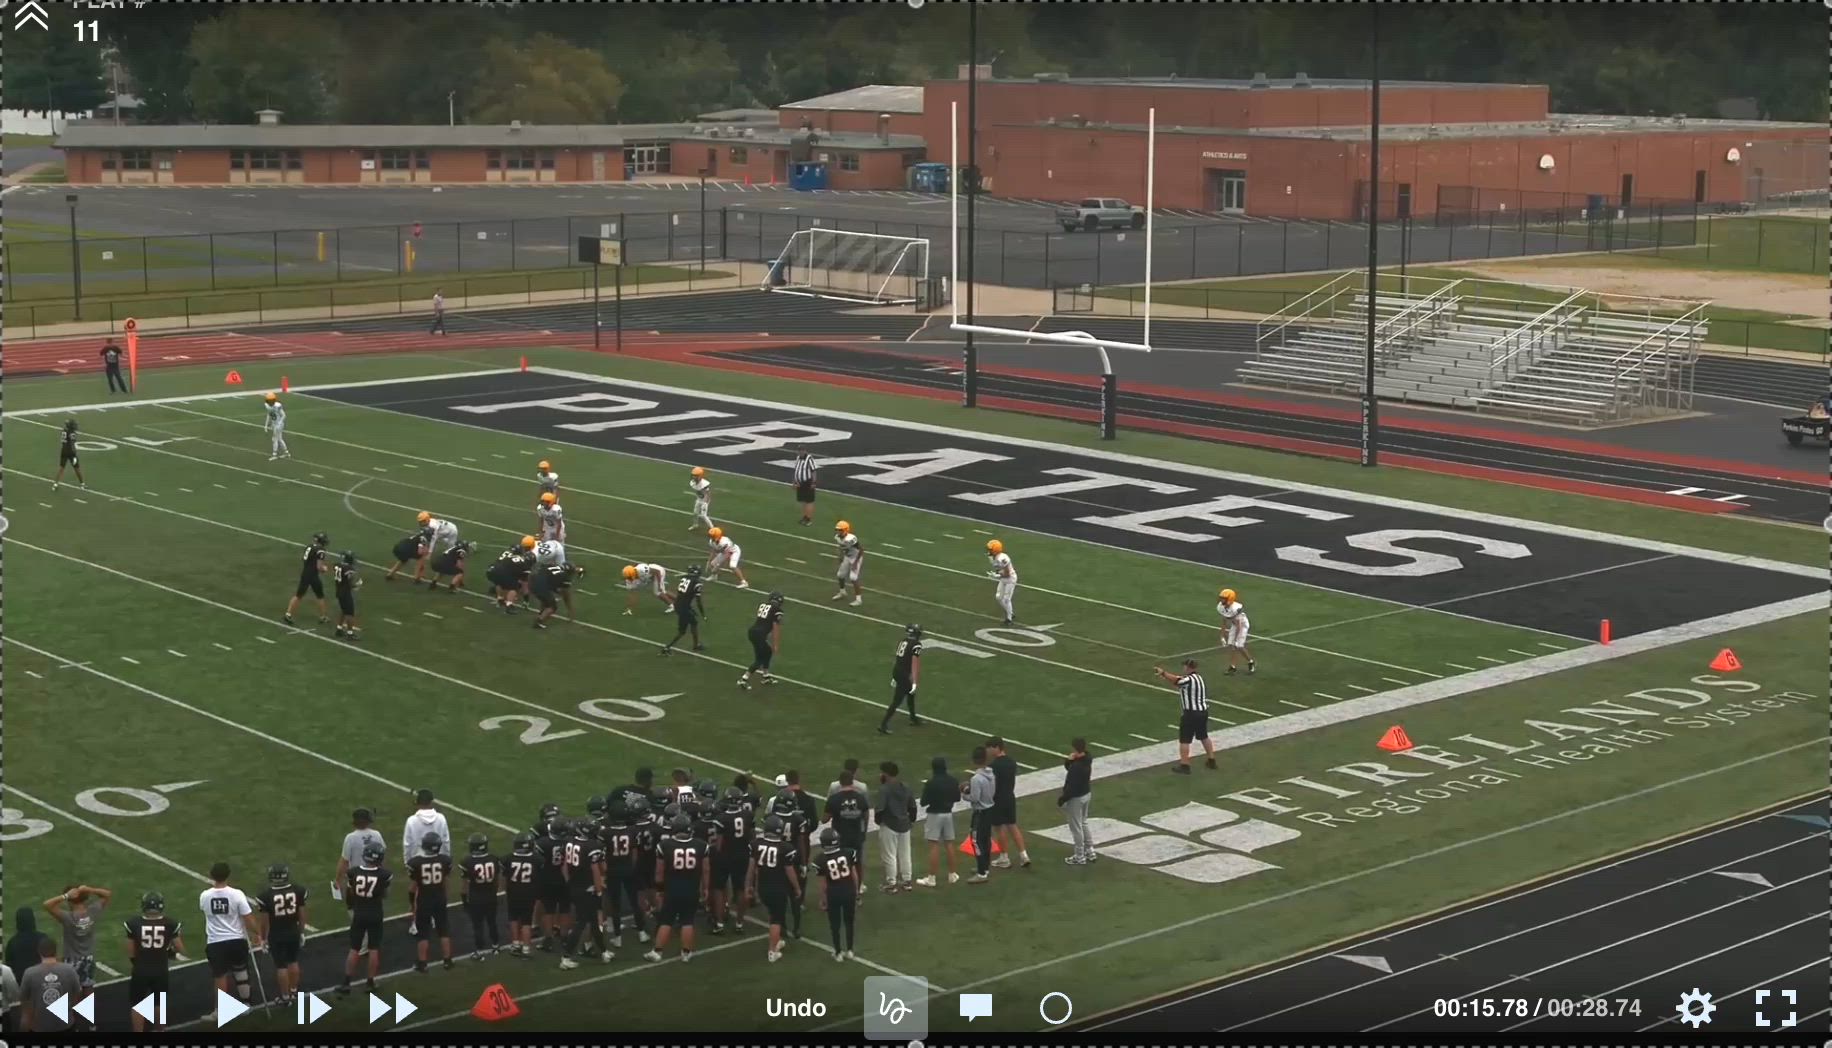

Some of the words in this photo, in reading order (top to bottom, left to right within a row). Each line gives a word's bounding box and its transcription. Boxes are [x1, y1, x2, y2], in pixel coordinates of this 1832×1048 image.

[447, 392, 1533, 577] PIRATES
[678, 578, 691, 593] 29
[479, 698, 667, 745] 20
[1217, 674, 1762, 816] FIRELANDS
[1393, 729, 1406, 747] 10
[1296, 766, 1523, 828] Regional
[1514, 726, 1674, 770] Health
[1663, 690, 1818, 729] System
[734, 817, 744, 838] 9
[565, 842, 580, 867] 86
[611, 835, 630, 856] 13
[758, 845, 778, 868] 70
[673, 848, 697, 870] 66
[827, 856, 850, 881] 83
[421, 863, 443, 885] 56
[474, 862, 495, 884] 30
[511, 862, 532, 883] 72
[355, 875, 378, 898] 27
[273, 892, 297, 916] 23
[141, 925, 165, 949] 55
[489, 989, 512, 1016] 30
